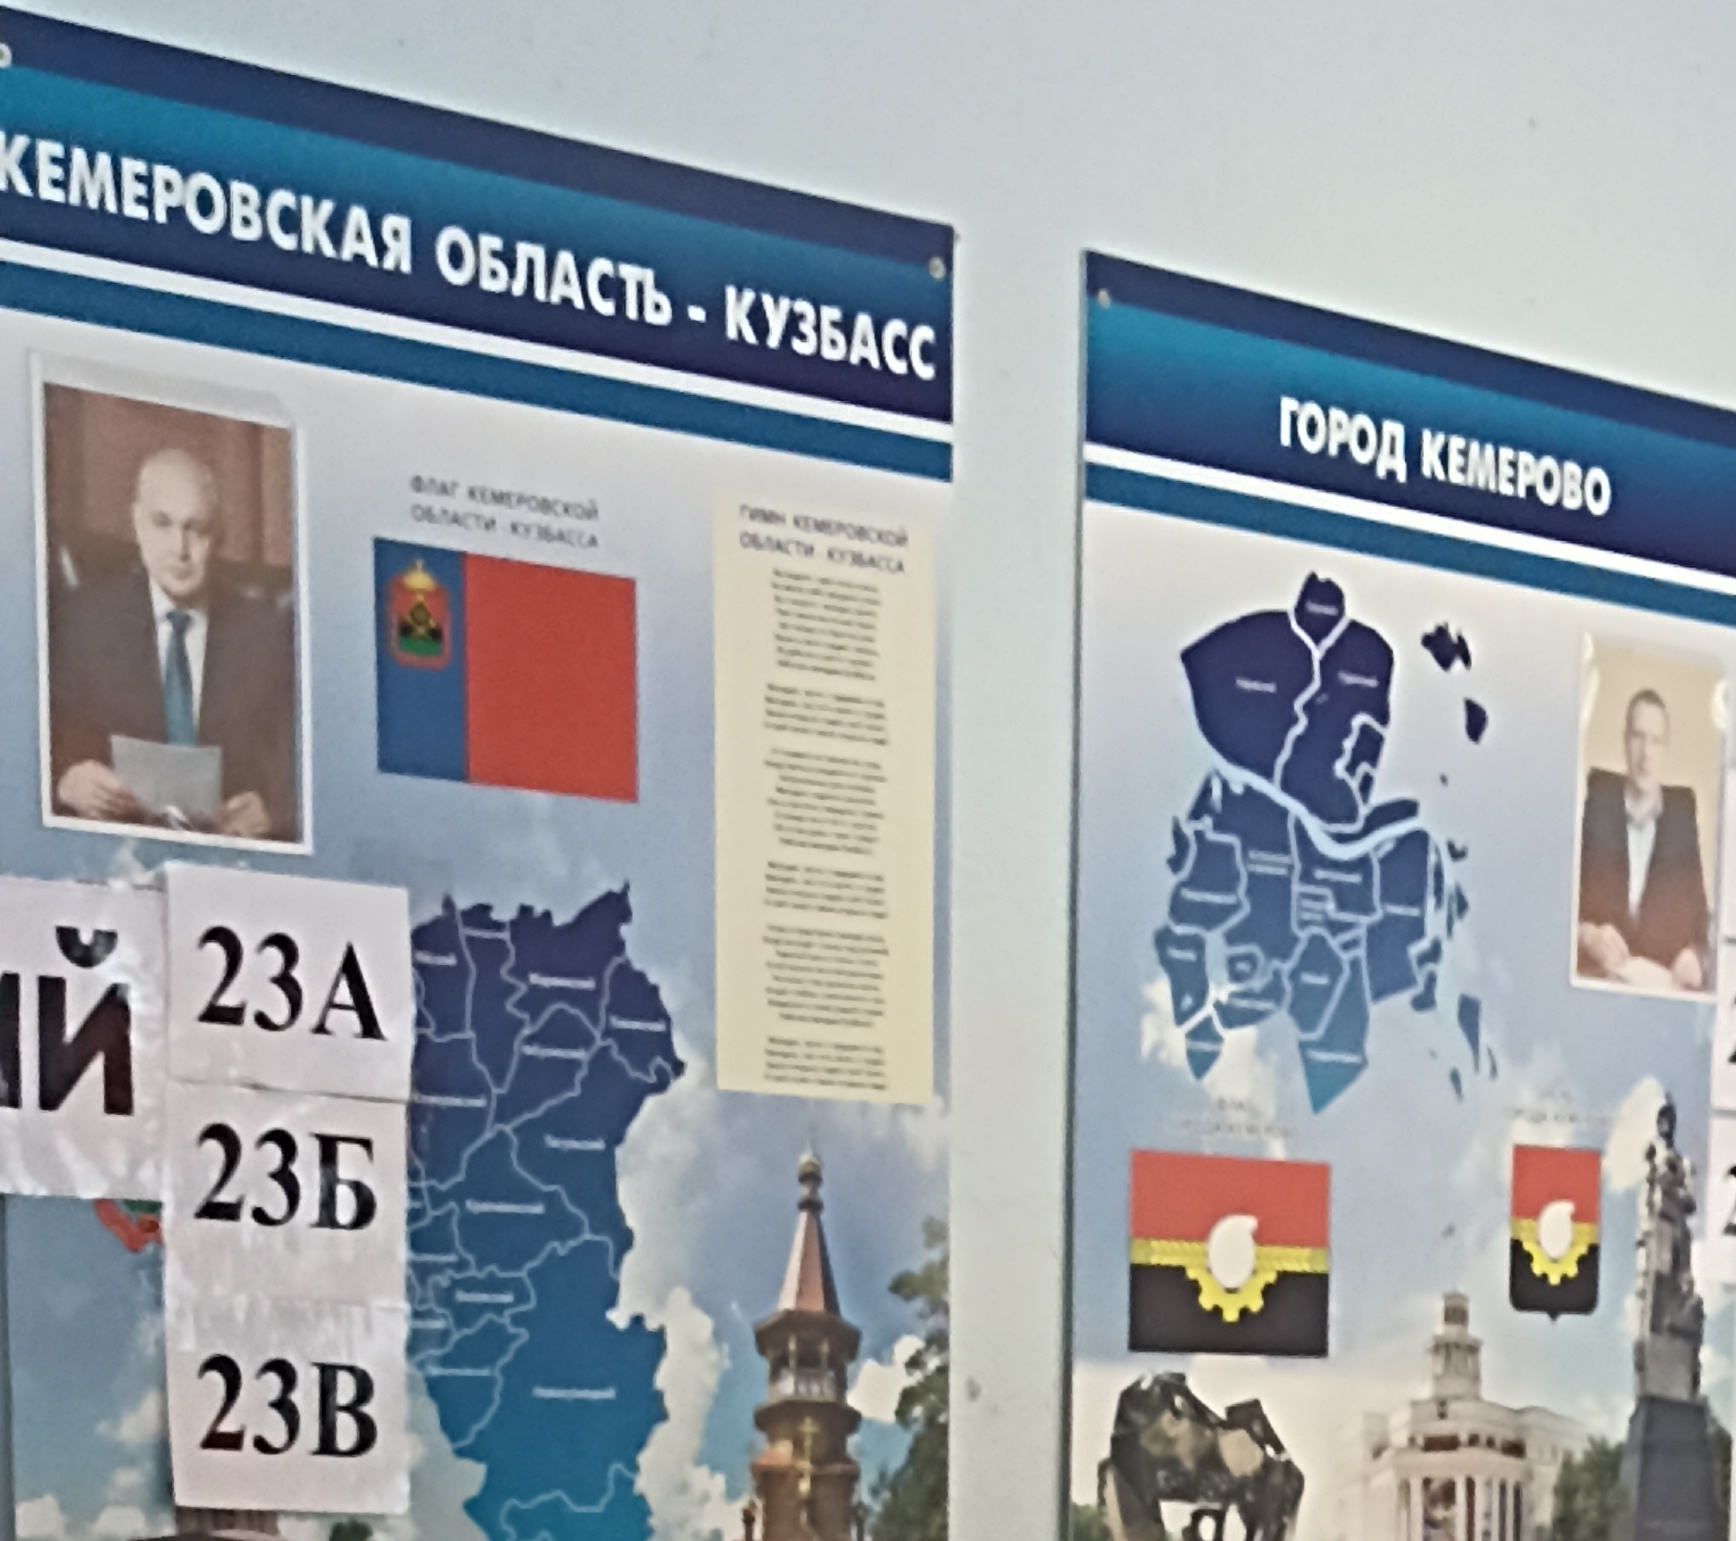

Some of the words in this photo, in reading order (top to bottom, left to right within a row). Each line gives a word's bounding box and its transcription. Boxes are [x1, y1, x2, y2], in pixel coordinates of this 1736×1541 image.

[0, 131, 412, 274] КЕМЕРОВСКАЯ
[435, 225, 673, 326] ОБЛАСТЬ
[725, 285, 936, 380] КУЗБАСС
[1280, 396, 1406, 483] ГОРОД
[1421, 428, 1612, 516] КЕМЕРОВО
[0, 925, 134, 1115] Й
[197, 925, 387, 1041] 23А
[194, 1121, 378, 1230] 23Б
[197, 1353, 378, 1458] 23В
